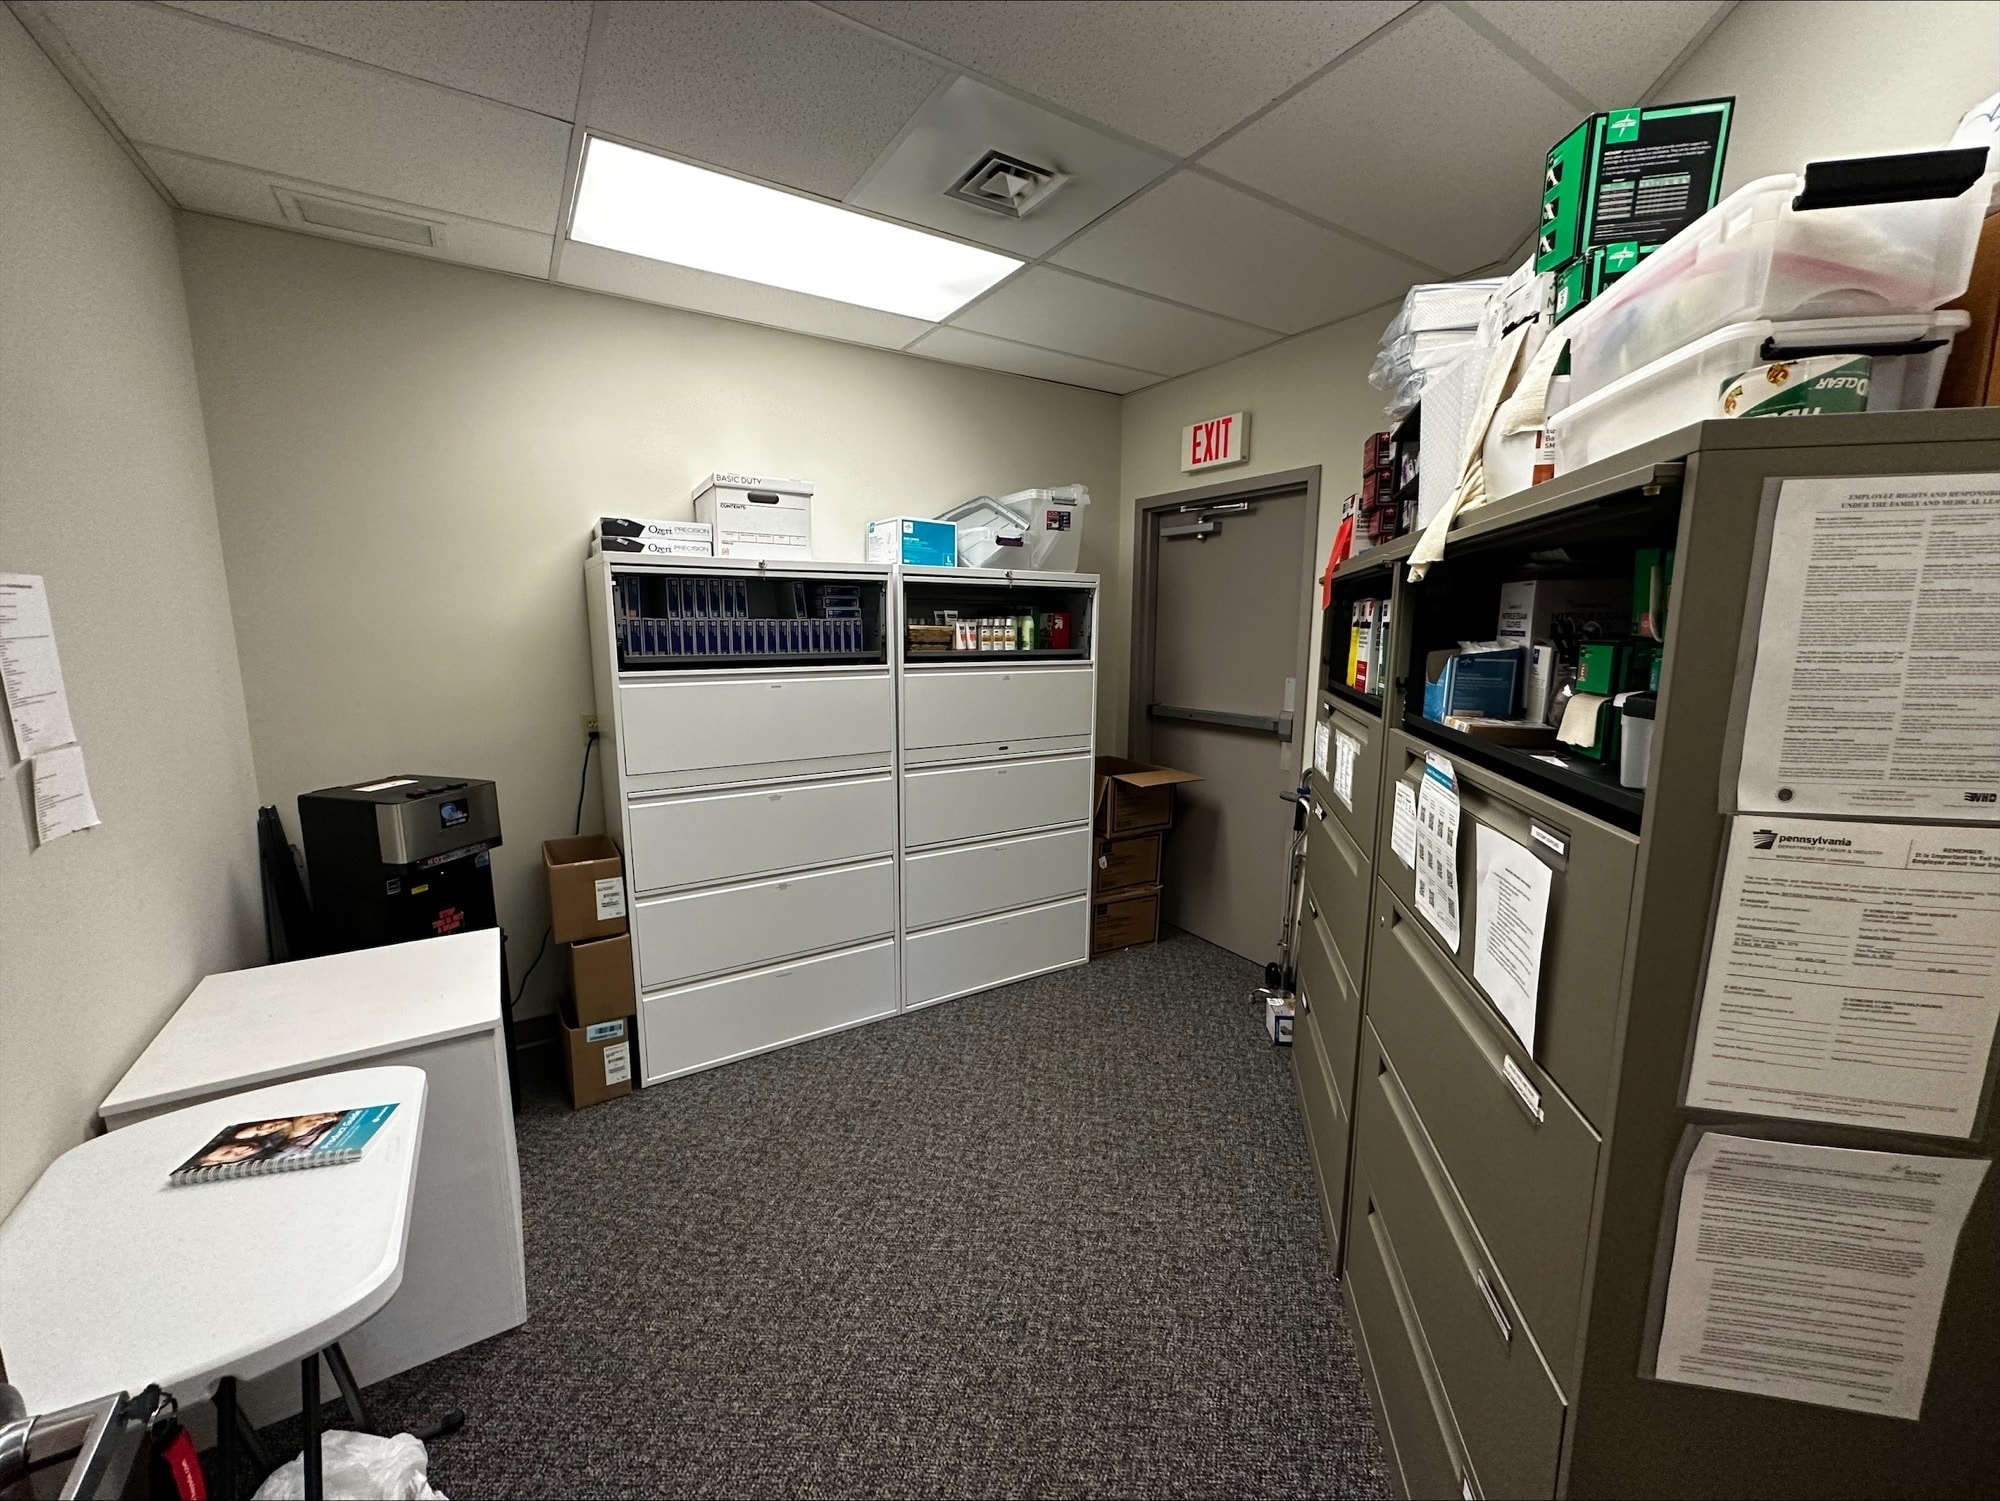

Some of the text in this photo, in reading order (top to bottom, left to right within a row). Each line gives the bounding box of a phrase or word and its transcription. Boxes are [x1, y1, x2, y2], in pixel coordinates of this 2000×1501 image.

[1192, 417, 1232, 465] EXIT
[716, 474, 762, 485] BASIC DUTY
[648, 524, 710, 535] Ozeri PRECISION
[648, 543, 672, 554] Ozeri
[1779, 835, 1852, 846] pennsylvania
